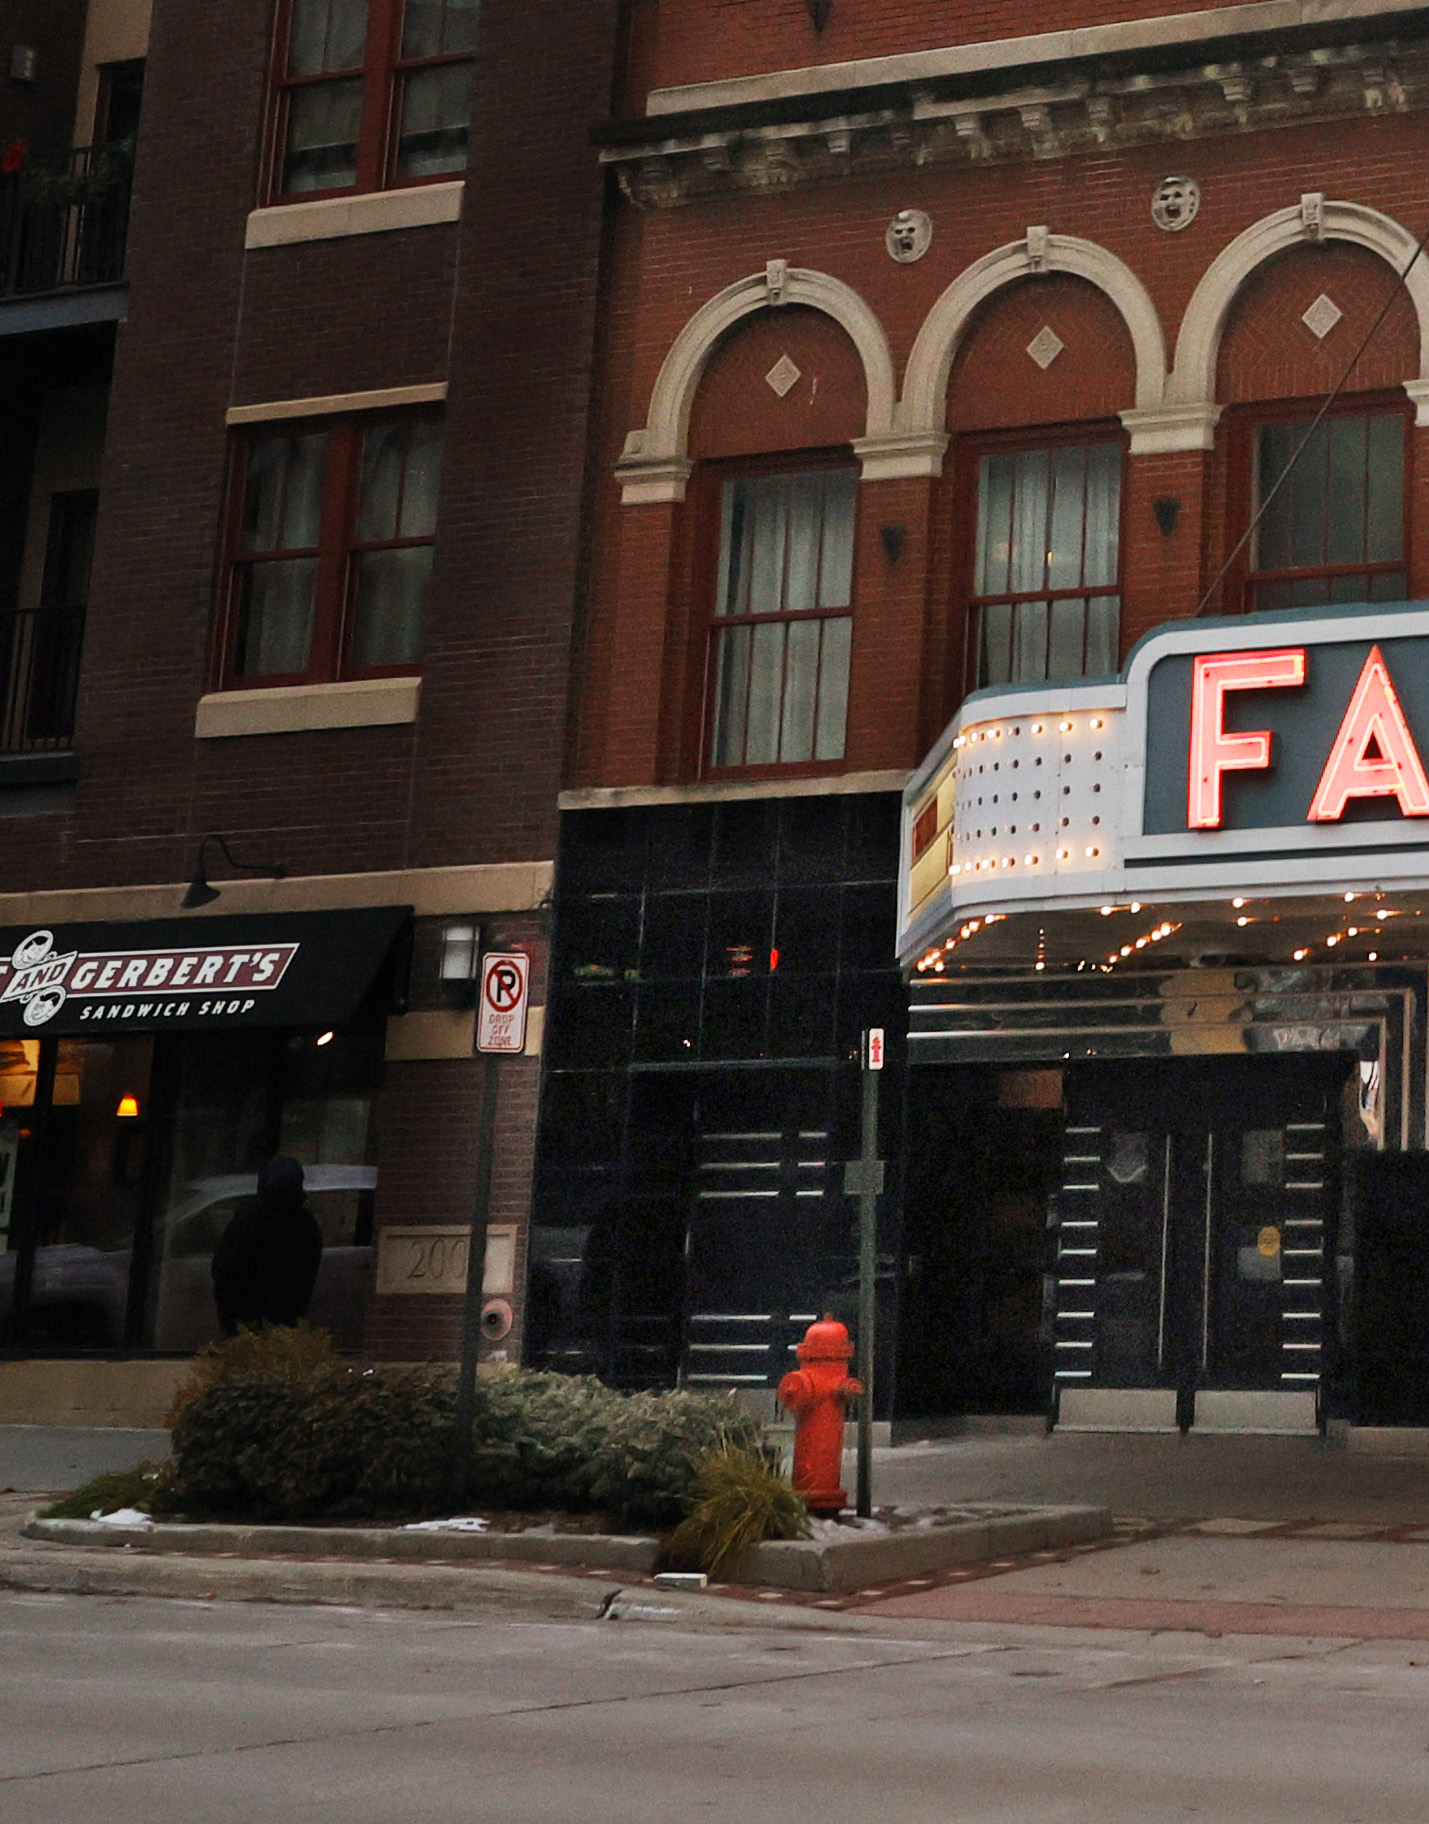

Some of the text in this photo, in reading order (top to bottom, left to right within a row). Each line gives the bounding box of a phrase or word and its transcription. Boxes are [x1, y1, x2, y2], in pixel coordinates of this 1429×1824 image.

[11, 951, 281, 993] AND GERBERT'S
[80, 999, 256, 1020] SANDWICH SHOP
[488, 1014, 515, 1025] DROP
[488, 1036, 512, 1046] ZONE
[407, 1238, 467, 1280] 200
